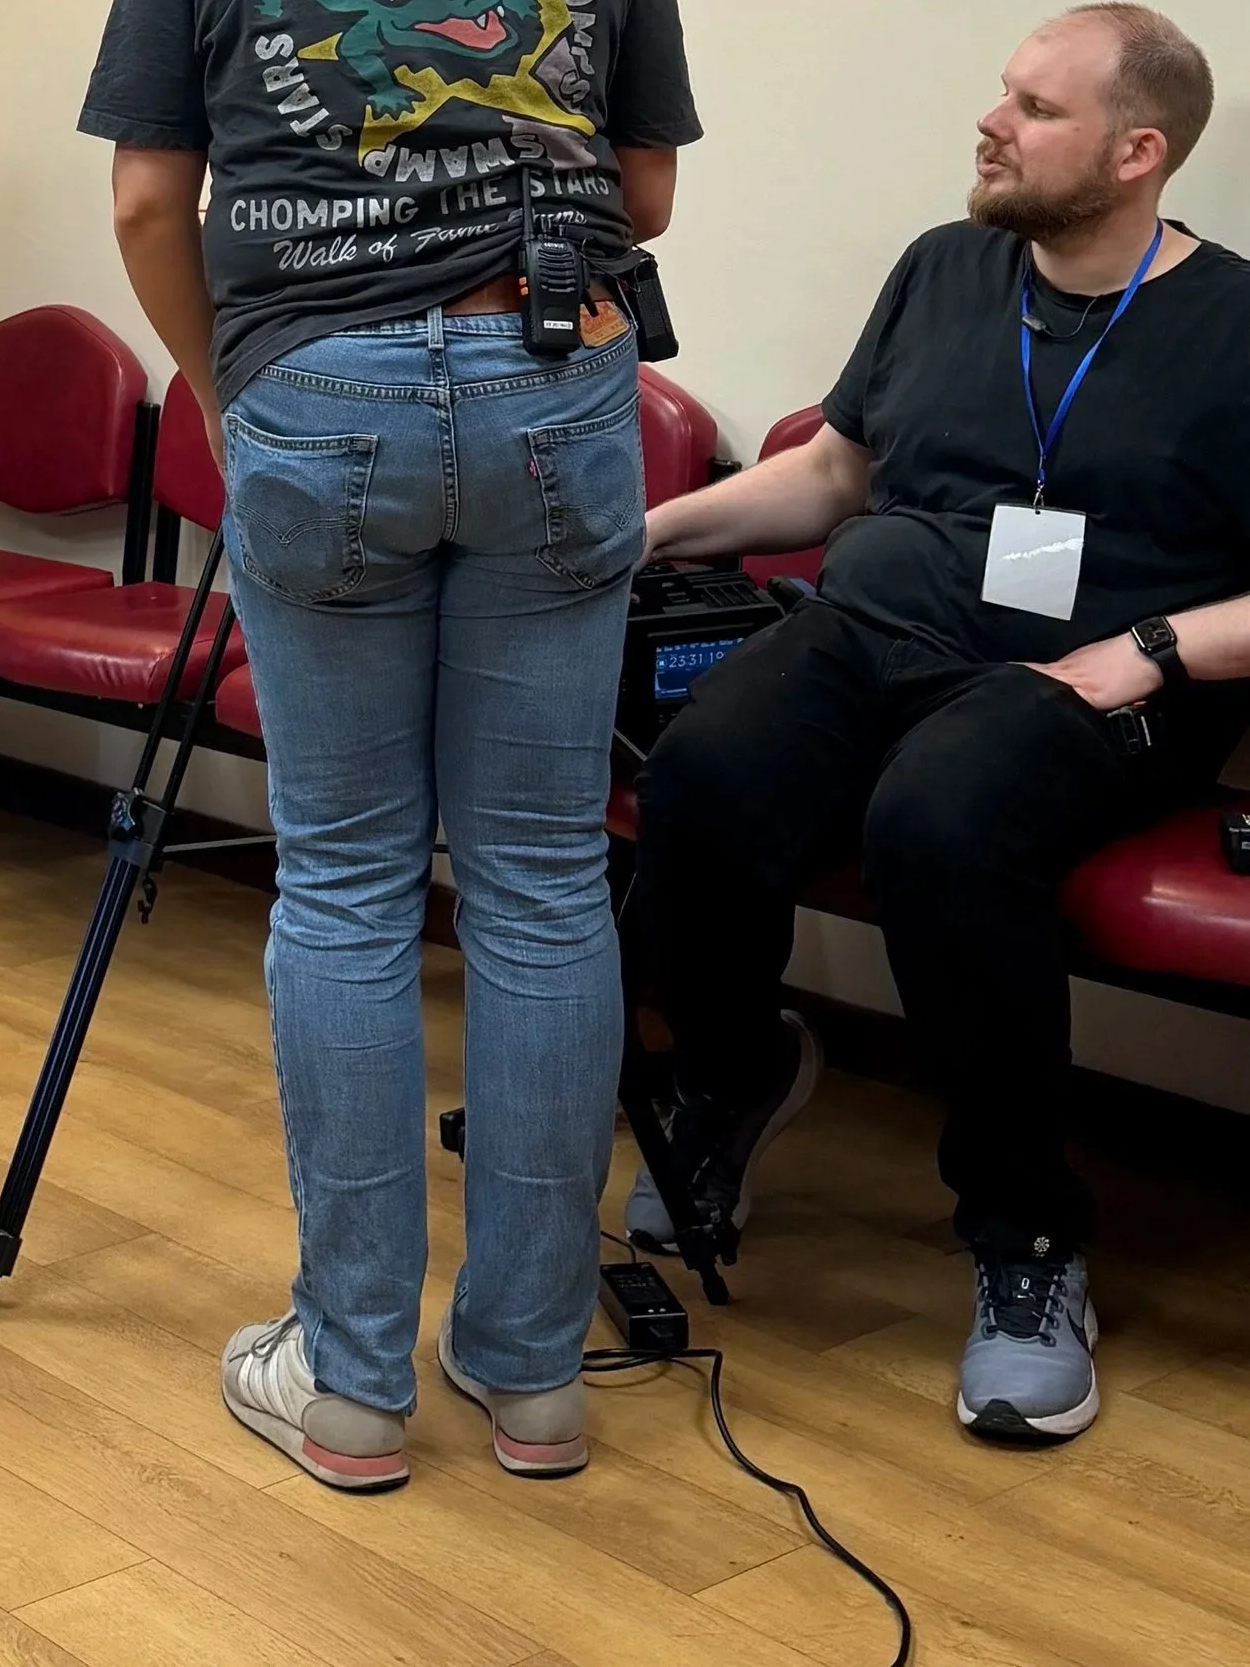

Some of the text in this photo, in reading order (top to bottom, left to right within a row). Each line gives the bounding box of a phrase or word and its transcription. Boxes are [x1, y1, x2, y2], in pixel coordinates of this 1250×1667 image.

[255, 33, 352, 151] STARS
[363, 134, 544, 182] SWAMP
[230, 169, 610, 231] CHOMPING THE STARS
[273, 235, 358, 271] Walk
[368, 234, 398, 262] of
